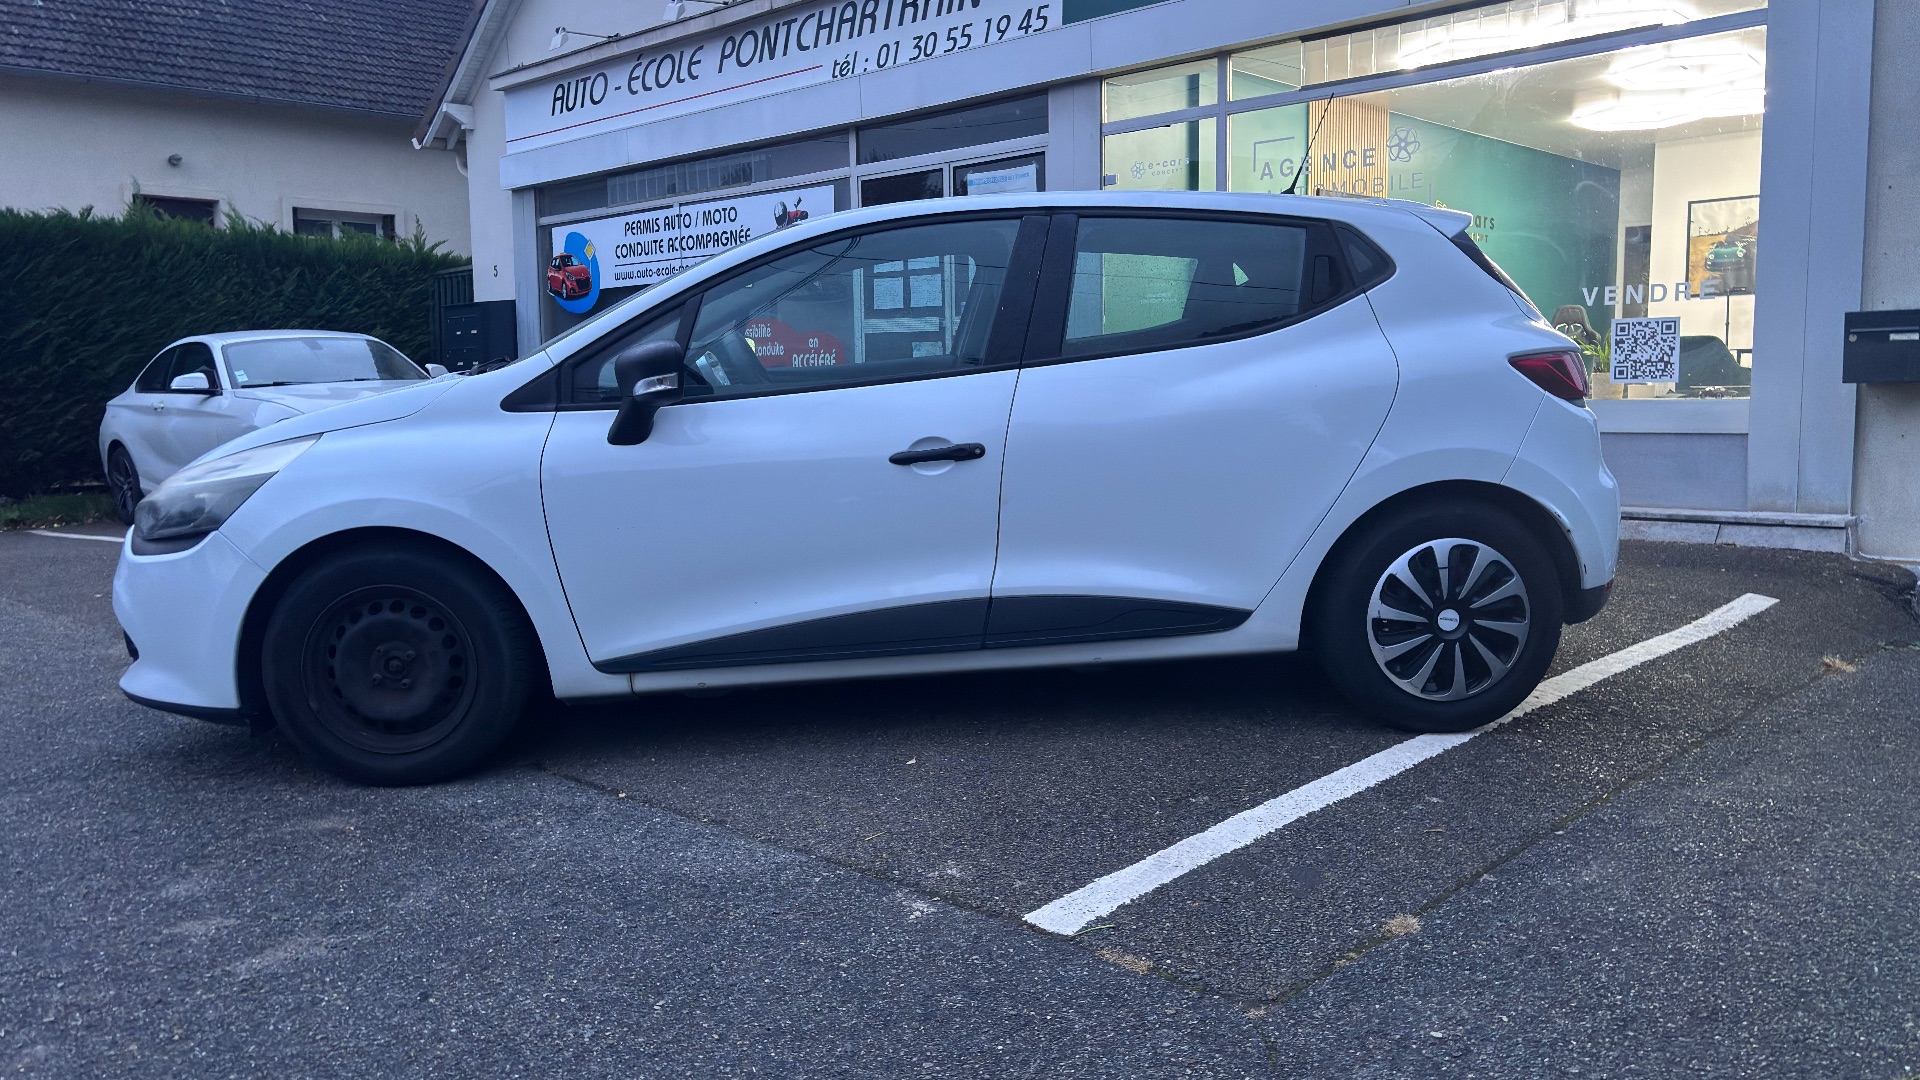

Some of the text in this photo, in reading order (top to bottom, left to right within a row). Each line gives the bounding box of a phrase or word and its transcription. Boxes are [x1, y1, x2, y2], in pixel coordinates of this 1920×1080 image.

[832, 51, 858, 79] tél
[876, 41, 900, 69] 01
[909, 31, 938, 61] 30
[944, 23, 973, 54] 55
[984, 14, 1011, 44] 19
[1017, 4, 1050, 35] 45
[551, 72, 609, 117] AUTO
[627, 45, 704, 95] ÉCOLE
[718, 0, 981, 74] PONTCHARTR
[1148, 157, 1190, 170] e-cars
[1151, 167, 1183, 177] CONCEPT
[1259, 147, 1376, 181] AGENCE
[1268, 172, 1424, 197] TOMOBILE
[624, 206, 738, 237] PERMIS AUTO / MOTO
[1474, 214, 1495, 230] ars
[614, 224, 751, 259] CONDUITE ACCOMPAGNÉE
[493, 265, 499, 277] 5
[1581, 279, 1717, 307] VENDRE
[744, 323, 772, 338] ssibilité
[808, 337, 819, 348] en
